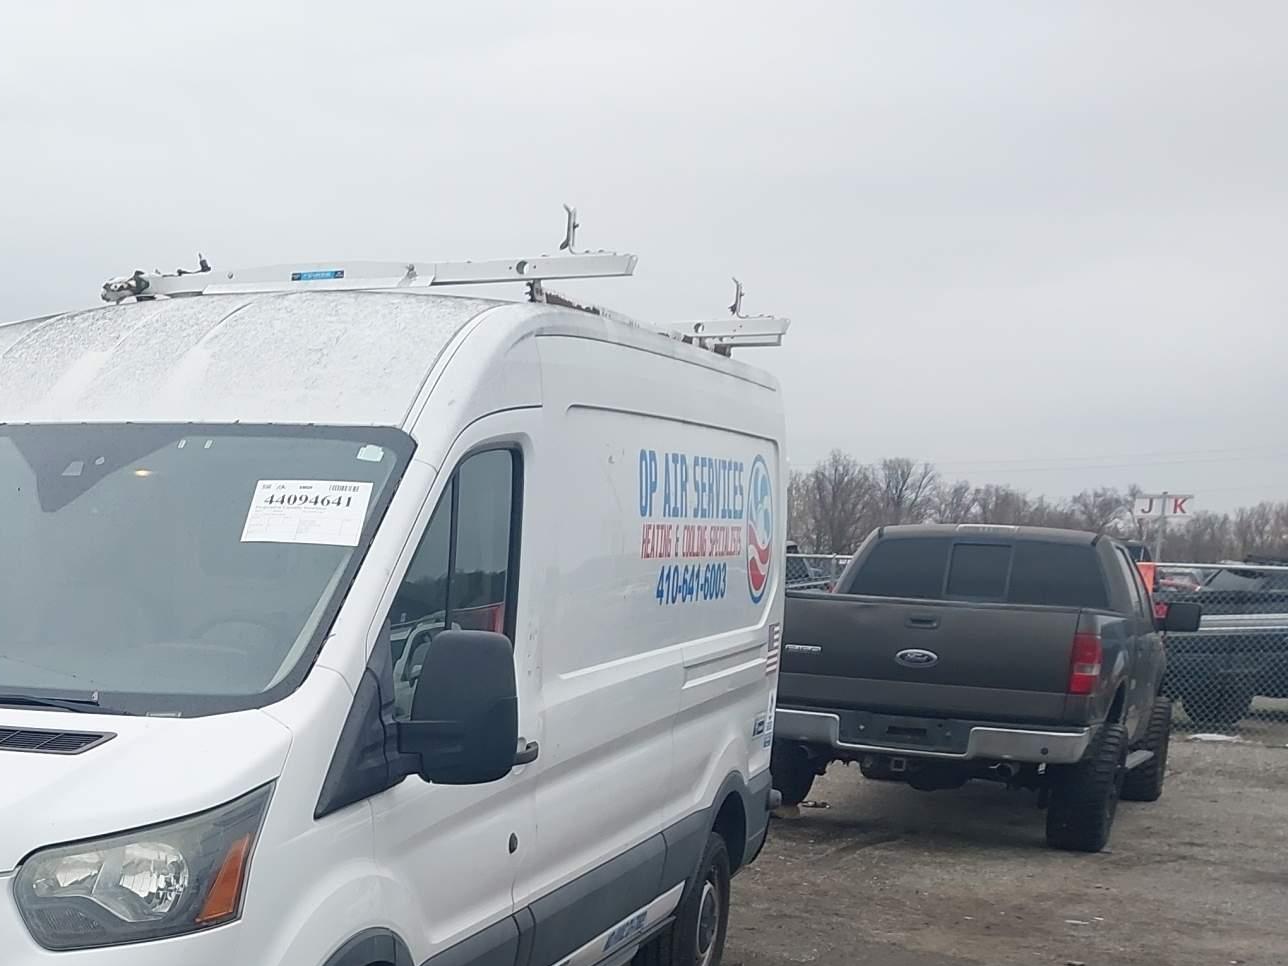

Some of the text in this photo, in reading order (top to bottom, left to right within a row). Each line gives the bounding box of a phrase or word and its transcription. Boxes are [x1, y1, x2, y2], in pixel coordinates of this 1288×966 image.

[264, 494, 352, 508] 44094641
[639, 448, 744, 520] OP AIR SERVICES
[641, 523, 673, 559] HEATING
[682, 525, 707, 558] COOLING
[655, 562, 728, 606] 410-641-6003
